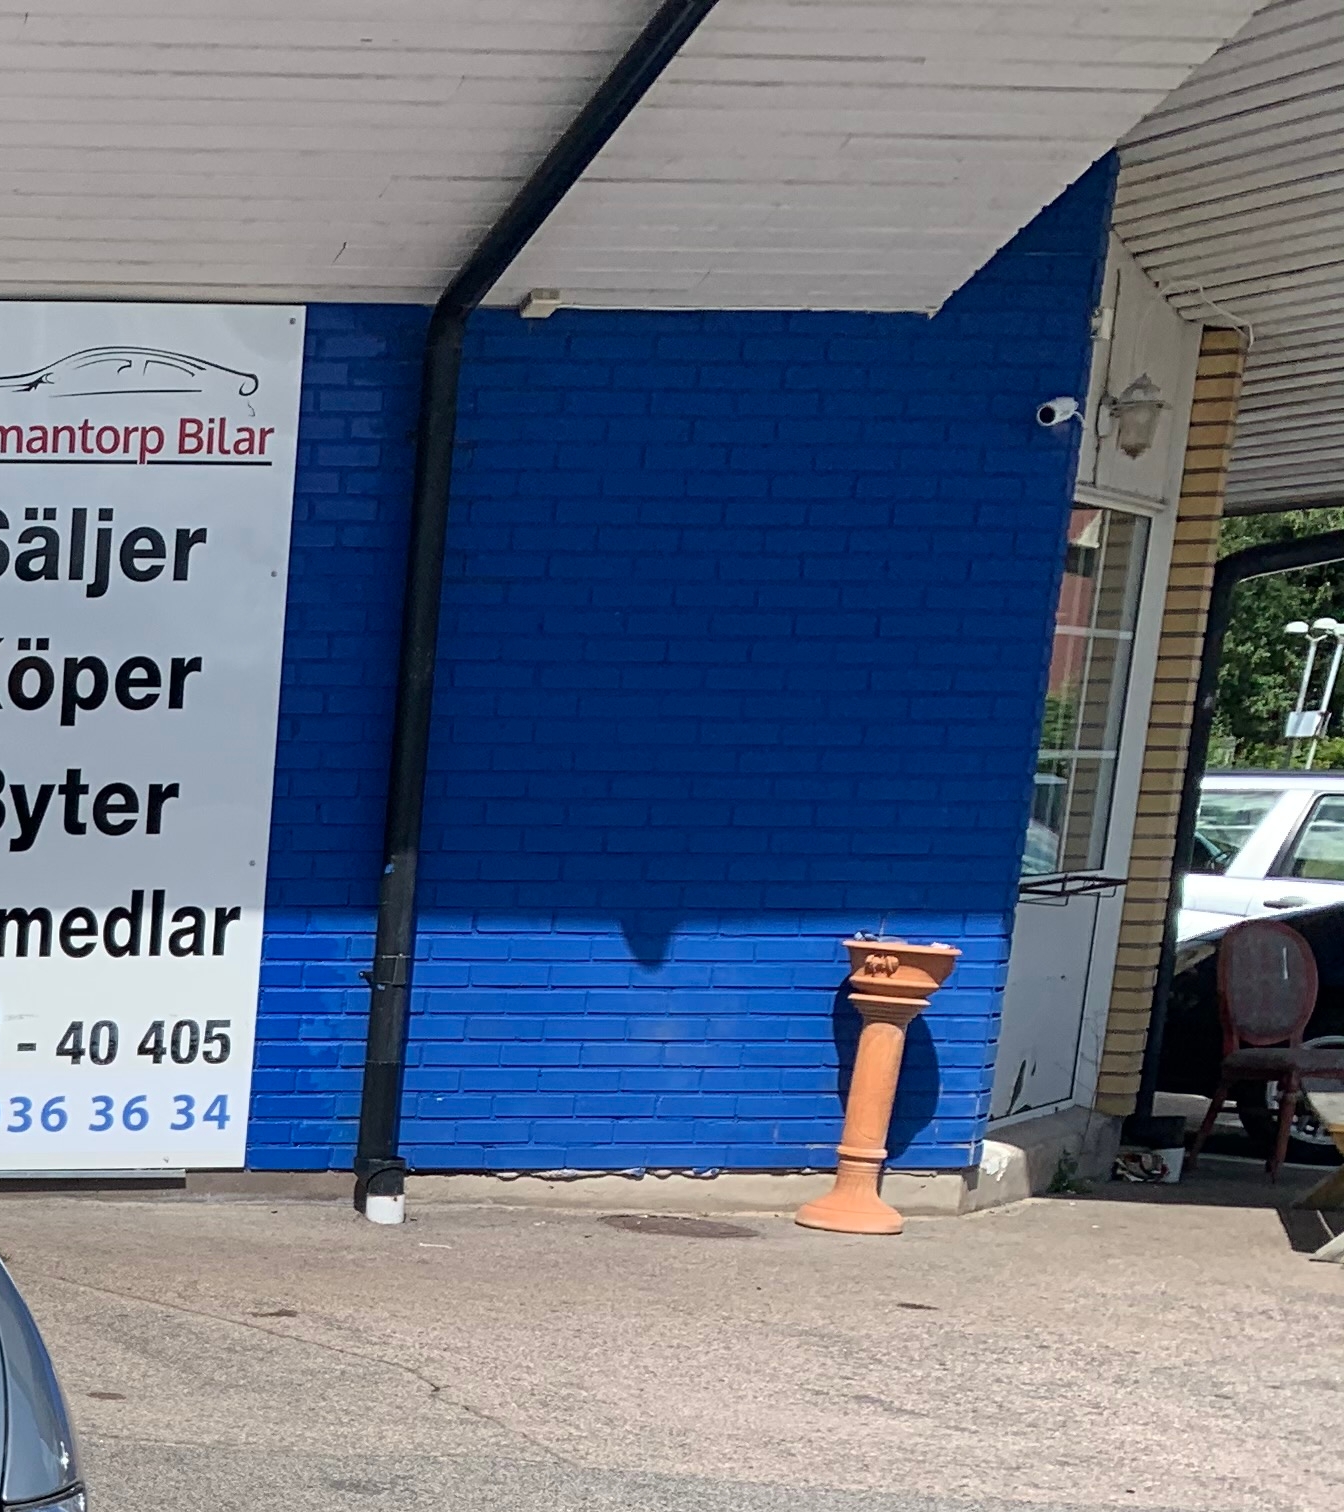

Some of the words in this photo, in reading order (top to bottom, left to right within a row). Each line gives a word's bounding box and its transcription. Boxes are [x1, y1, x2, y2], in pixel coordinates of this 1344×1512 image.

[178, 417, 274, 455] Bilar
[55, 1020, 119, 1066] 40
[136, 1019, 231, 1065] 405
[88, 1094, 149, 1132] 36
[170, 1094, 231, 1131] 34
